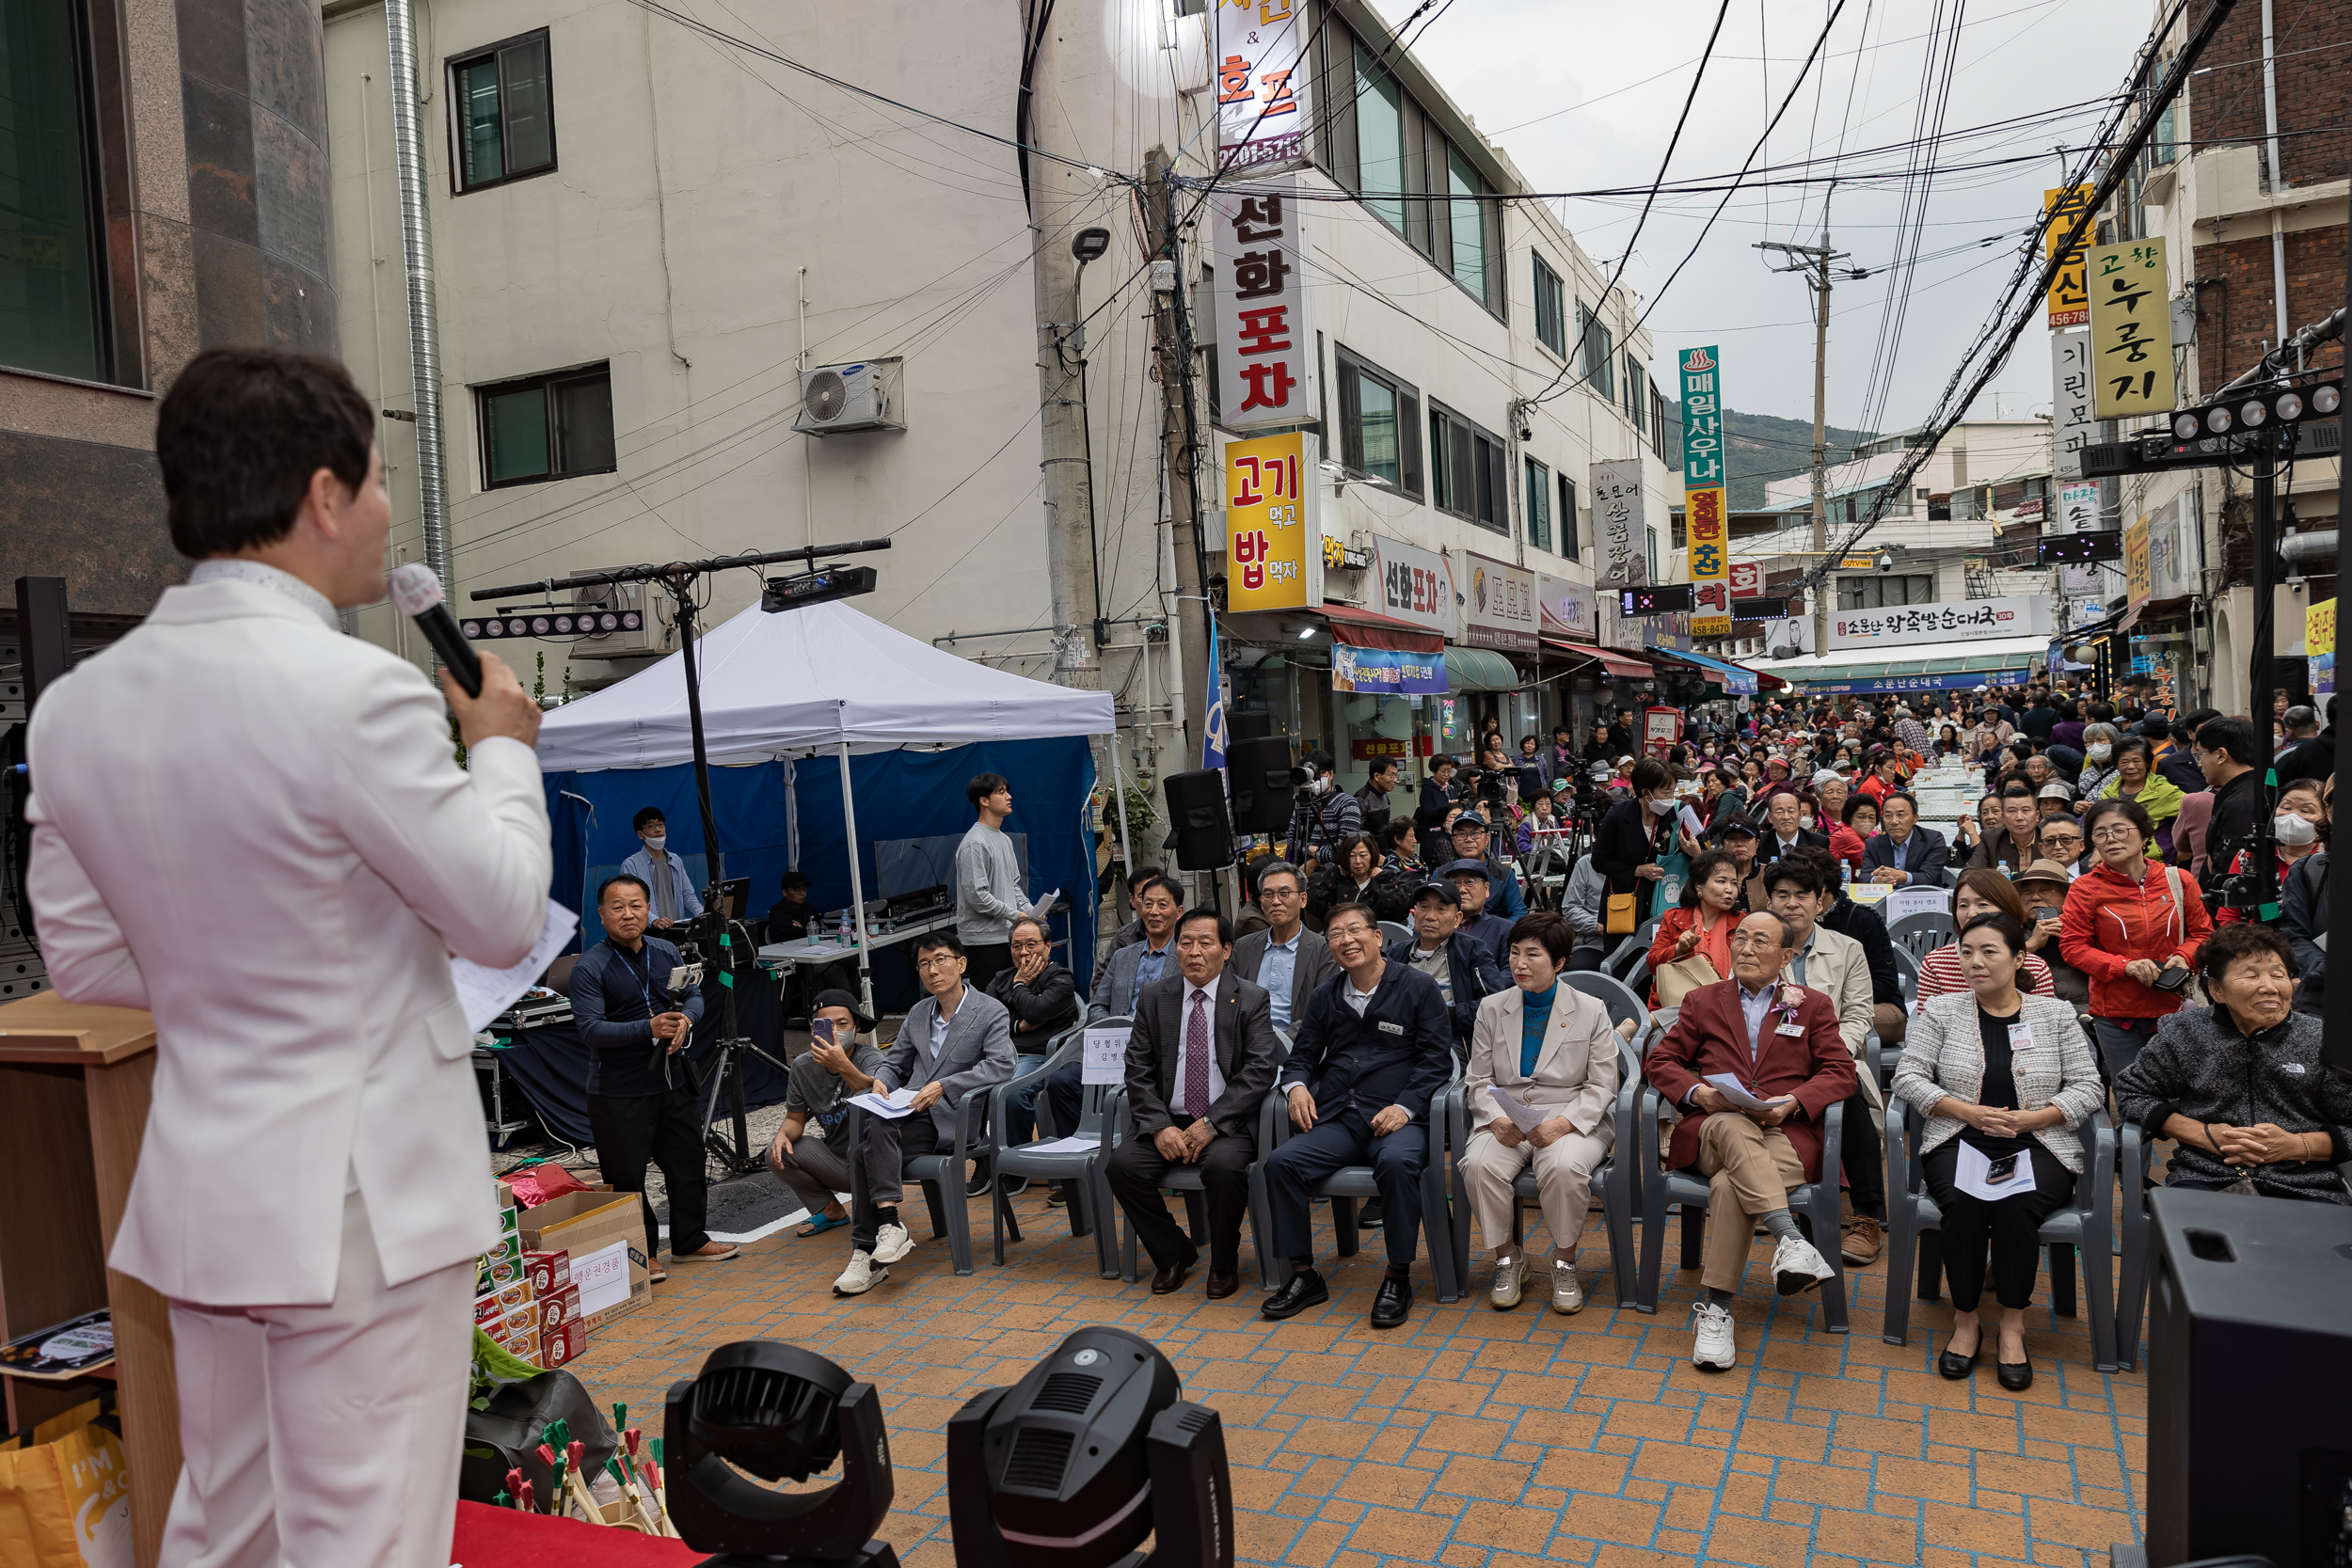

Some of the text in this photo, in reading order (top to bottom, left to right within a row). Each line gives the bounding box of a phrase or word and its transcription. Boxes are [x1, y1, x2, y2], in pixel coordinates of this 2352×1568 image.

[1247, 32, 1260, 44] &
[2099, 246, 2158, 277] 고향
[1232, 192, 1297, 412] 선화포차
[2105, 278, 2155, 401] 누룽지
[1687, 372, 1721, 478] 매일사우나
[1232, 453, 1297, 508] 고기
[1268, 503, 1297, 531] 먹고
[1692, 490, 1721, 540] 영일만
[1233, 529, 1289, 592] 밥
[1268, 558, 1298, 585] 먹자
[1692, 544, 1722, 577] 수산
[1386, 560, 1438, 615] 선화포차
[1730, 563, 1764, 596] 회
[1692, 624, 1729, 636] 458-8470
[1848, 619, 1883, 635] 소문난
[574, 1257, 620, 1285] 행운권경품
